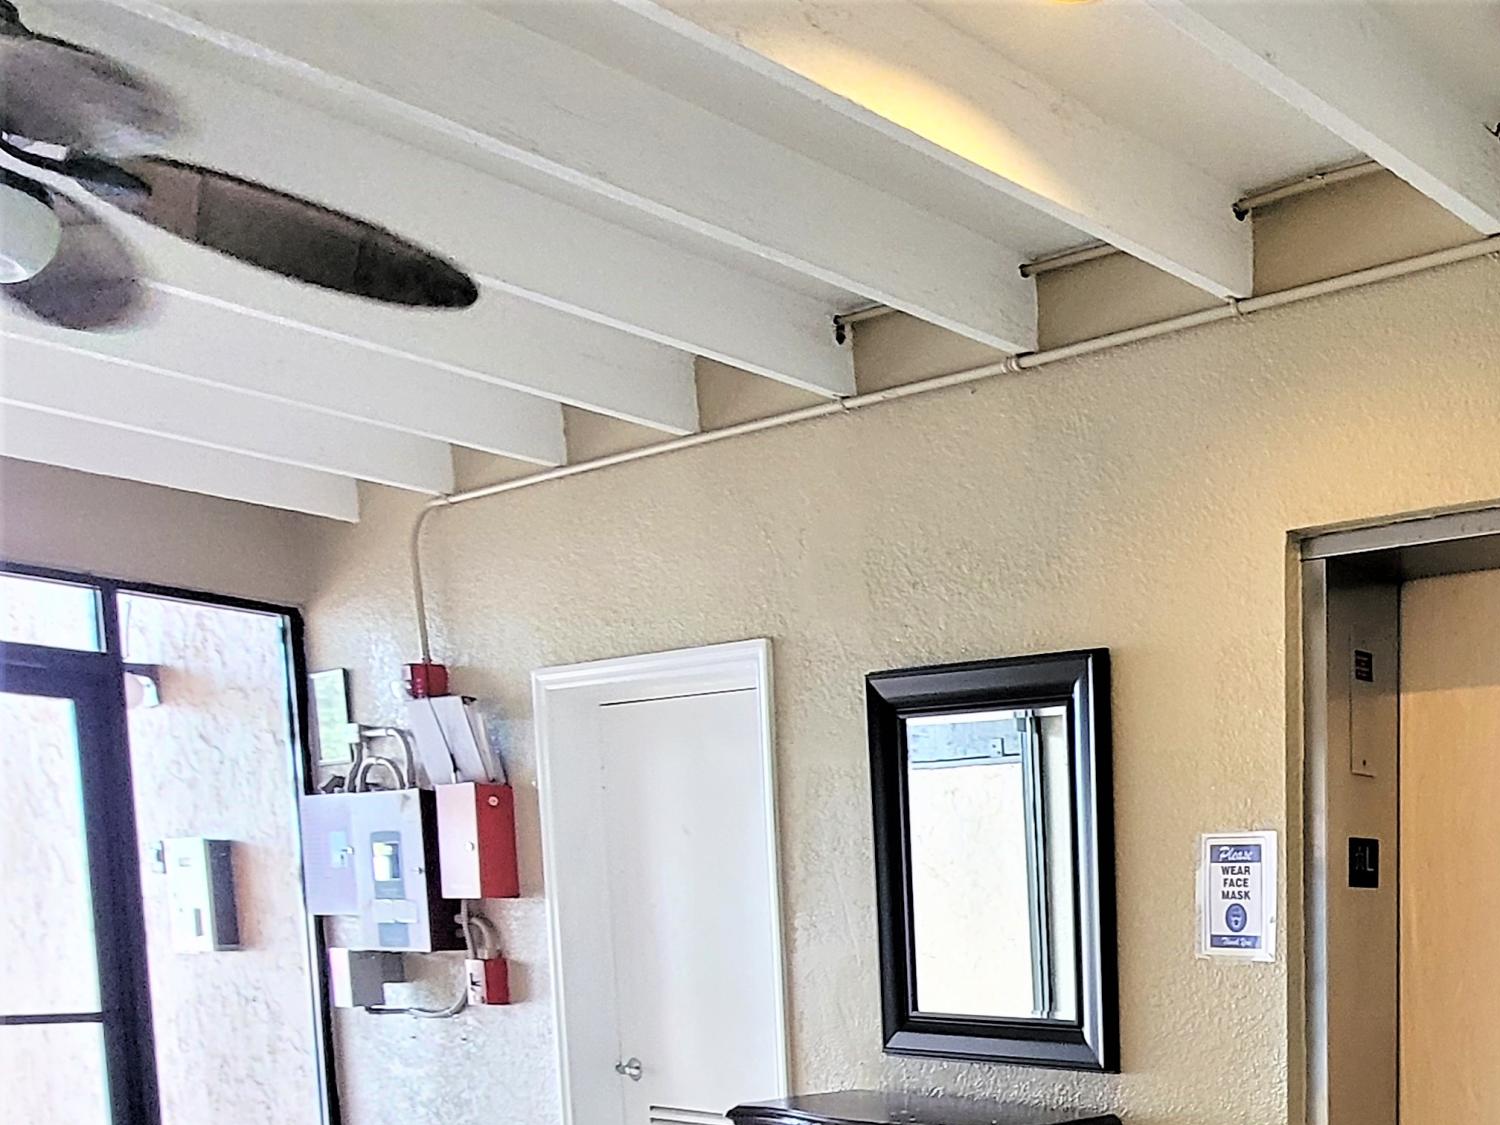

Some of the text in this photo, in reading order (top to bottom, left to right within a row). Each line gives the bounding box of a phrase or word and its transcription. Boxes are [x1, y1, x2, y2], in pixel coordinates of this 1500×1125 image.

[1220, 865, 1251, 876] WEAR
[1223, 877, 1249, 888] FACE
[1221, 890, 1251, 900] MASK
